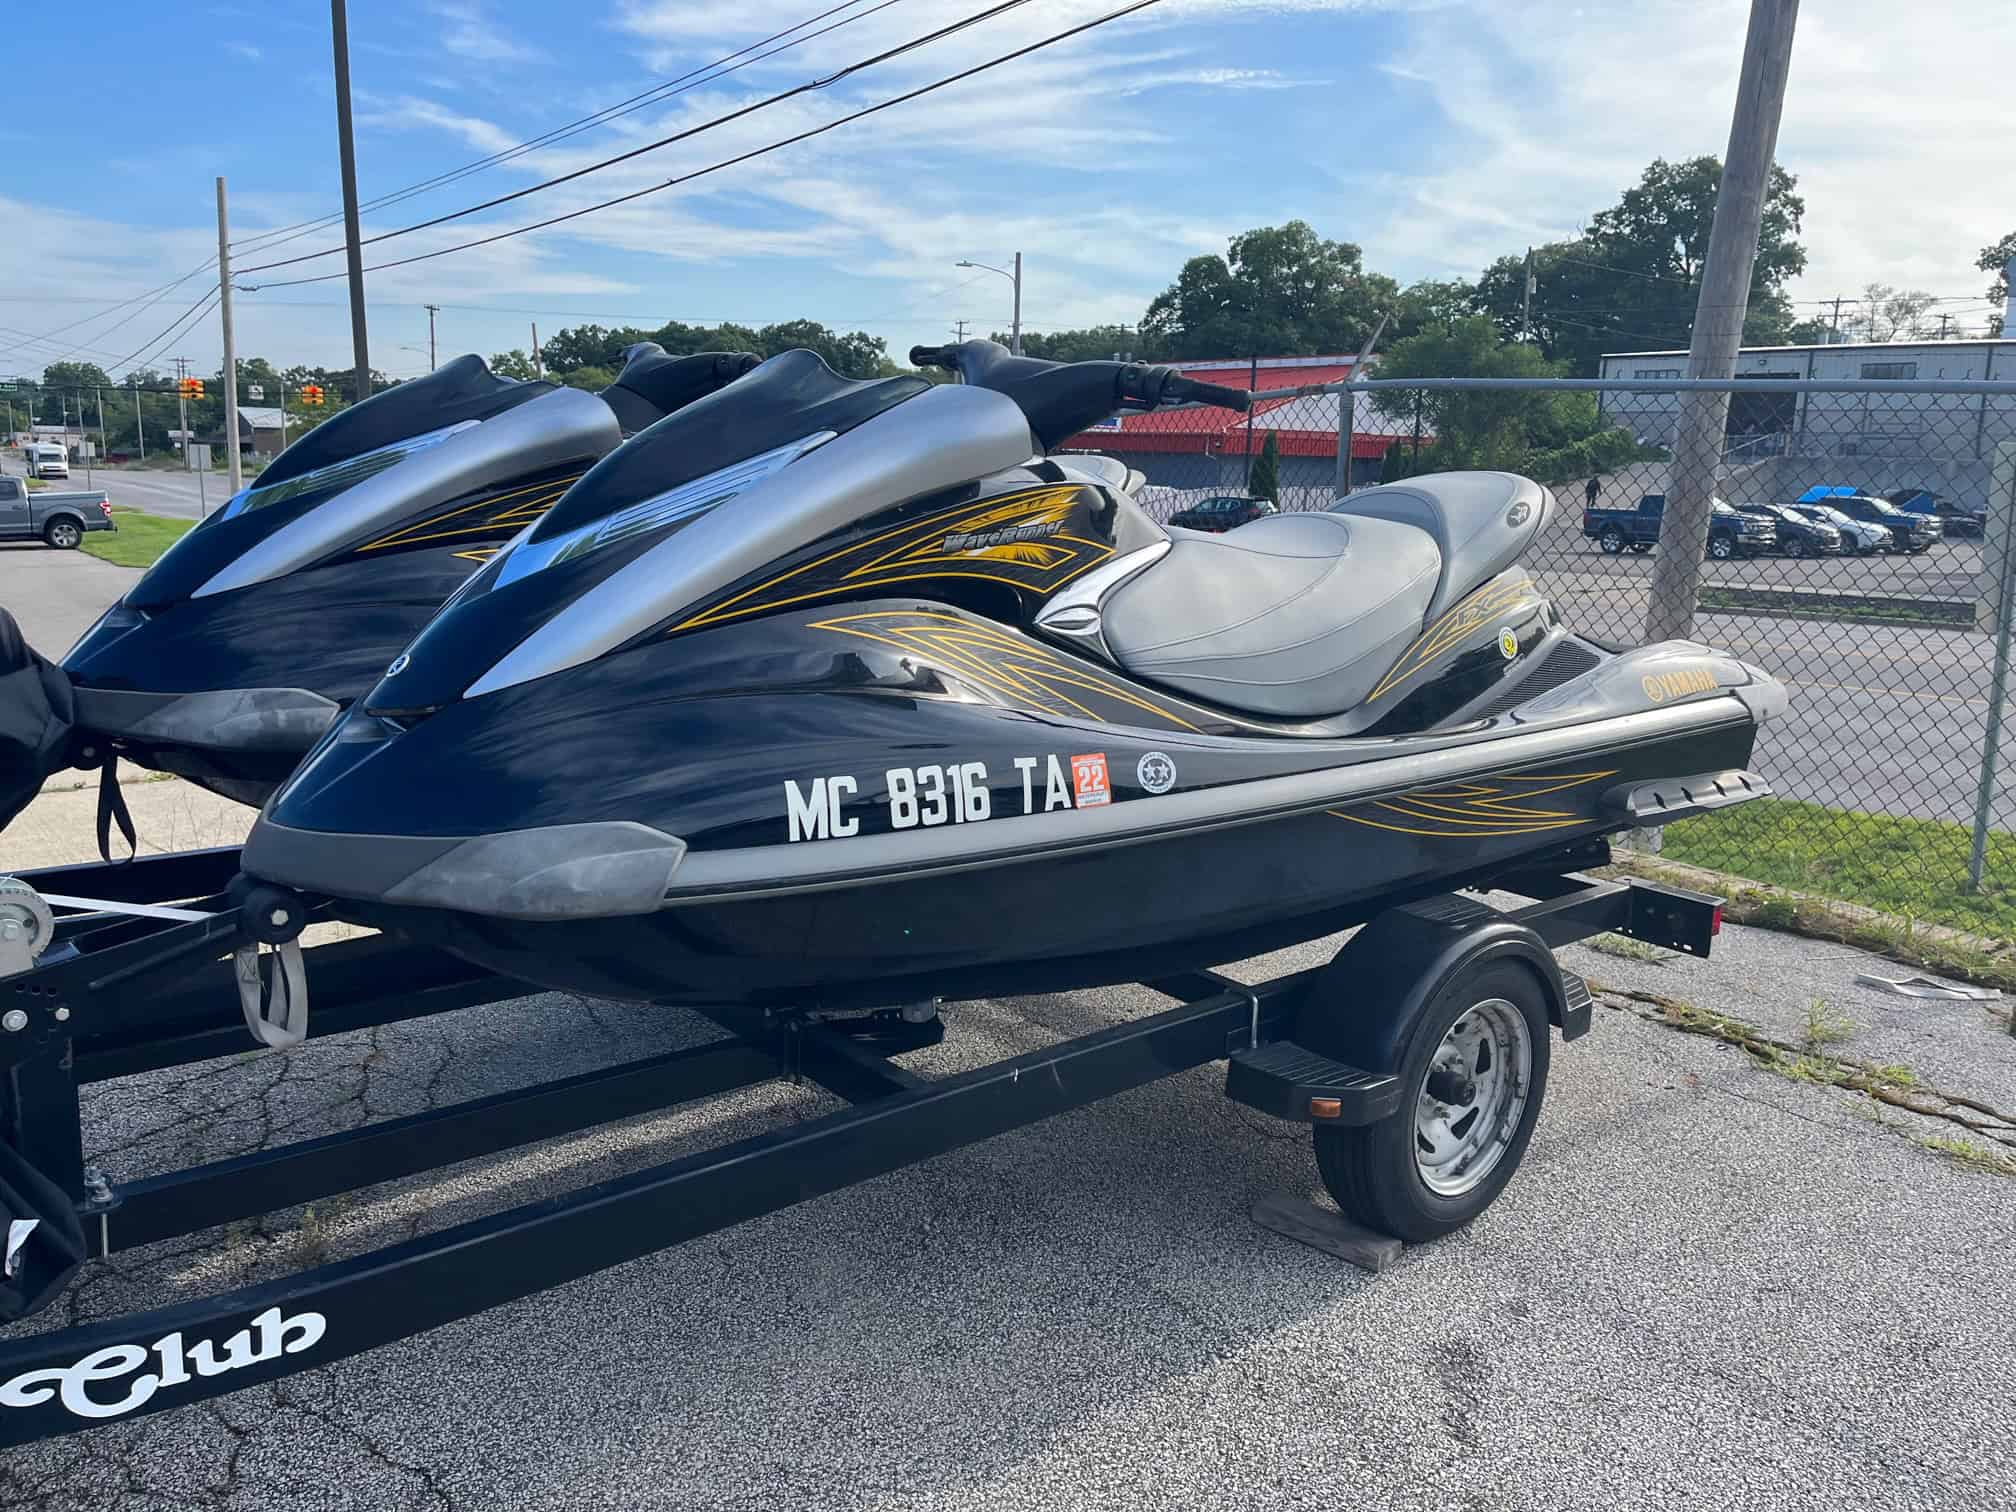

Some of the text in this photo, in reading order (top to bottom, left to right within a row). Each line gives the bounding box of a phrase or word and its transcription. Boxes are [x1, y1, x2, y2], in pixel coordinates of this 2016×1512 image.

[943, 520, 1065, 552] WaveRunner
[1657, 671, 1718, 697] YAMAHA
[1078, 765, 1105, 793] 22
[784, 776, 859, 842] MC
[886, 761, 991, 829] 8316
[1013, 754, 1072, 814] TA
[0, 1307, 327, 1418] Club
